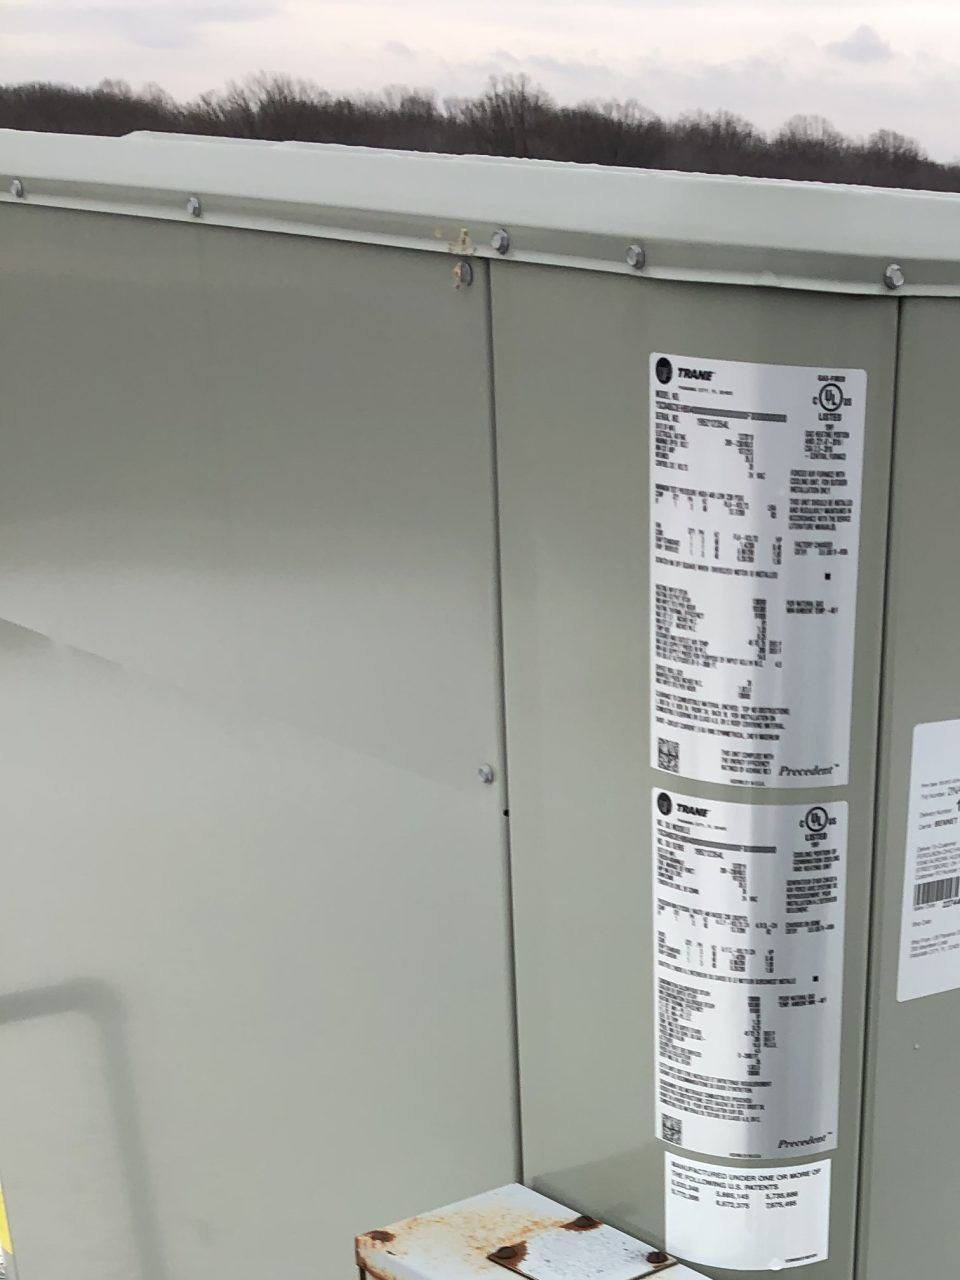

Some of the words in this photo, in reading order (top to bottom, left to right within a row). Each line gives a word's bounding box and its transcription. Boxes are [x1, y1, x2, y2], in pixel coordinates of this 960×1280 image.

[678, 367, 713, 381] TRANE
[779, 764, 834, 777] Precedent
[676, 803, 708, 818] TRANE
[778, 1134, 826, 1149] Precedent
[671, 1162, 728, 1180] MANUFACTURED
[729, 1174, 757, 1182] UNDER
[758, 1174, 775, 1182] ONE
[790, 1170, 811, 1180] MORE
[684, 1174, 726, 1189] FOLLOWING
